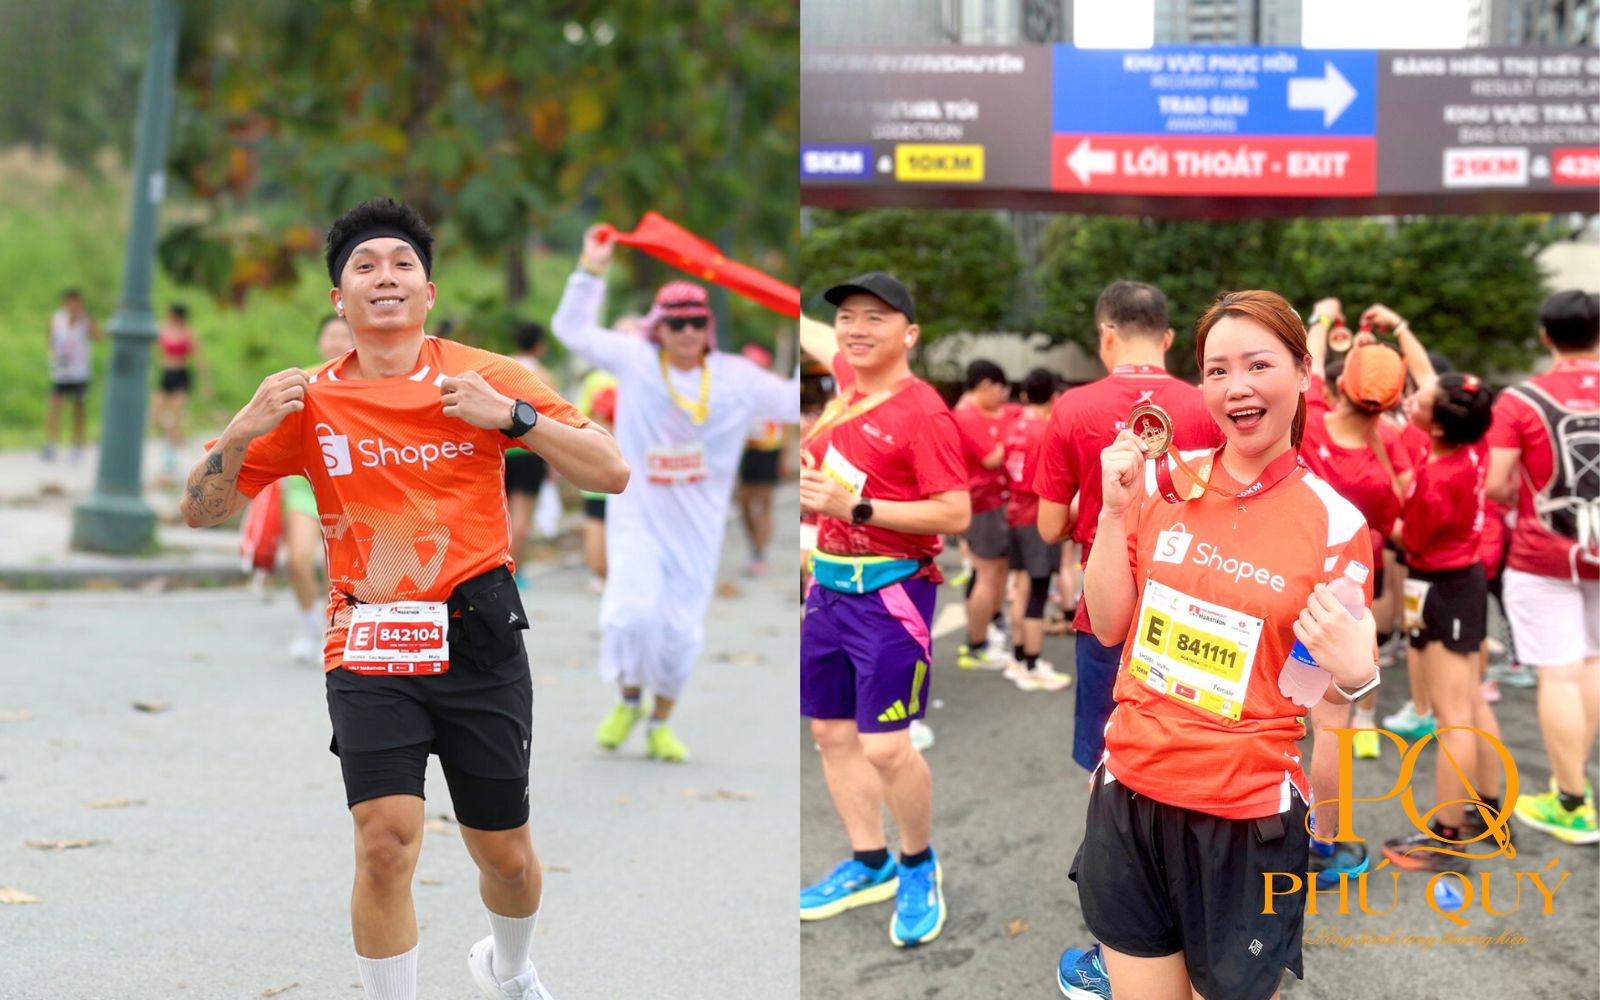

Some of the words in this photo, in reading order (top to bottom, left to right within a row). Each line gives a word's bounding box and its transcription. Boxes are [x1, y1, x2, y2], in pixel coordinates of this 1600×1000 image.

[1470, 79, 1533, 96] RESULT
[1158, 95, 1207, 115] TRAO
[1443, 104, 1490, 124] KHU
[1458, 126, 1495, 143] BAG
[907, 154, 974, 170] 10KM
[1174, 145, 1267, 177] THOÁT
[1287, 152, 1349, 177] EXIT
[1452, 157, 1520, 177] 21KM
[358, 438, 474, 471] Shopee
[1192, 542, 1286, 592] Shopee
[354, 626, 370, 647] E
[380, 628, 440, 641] 842104
[1146, 615, 1165, 647] E
[1177, 633, 1237, 669] 841111
[1213, 684, 1234, 696] Female
